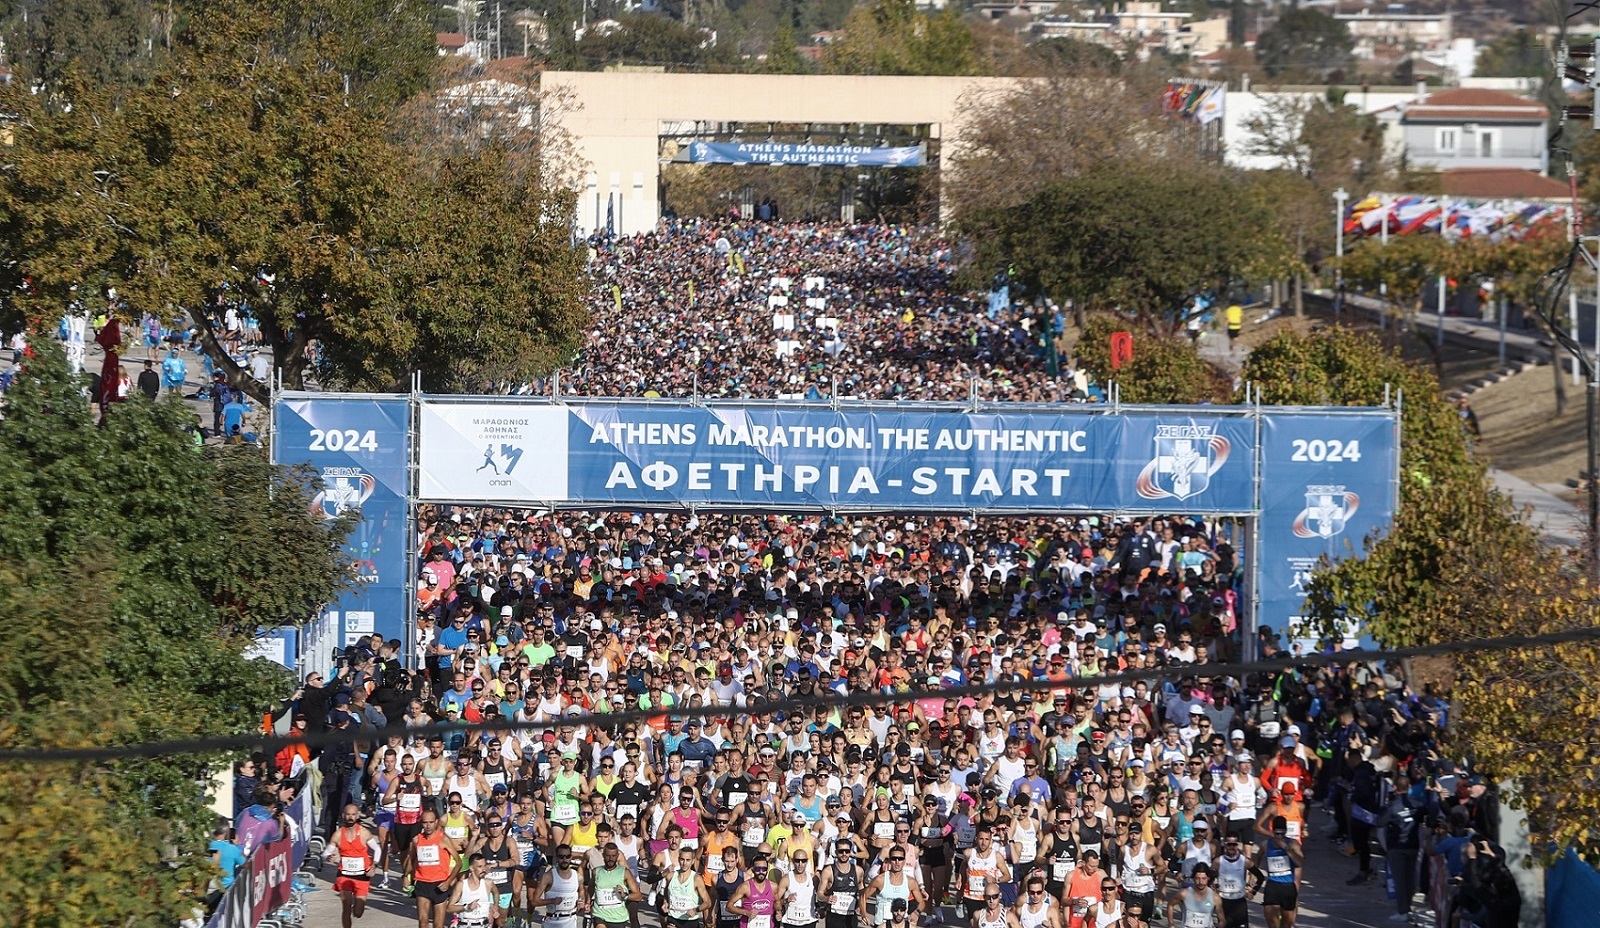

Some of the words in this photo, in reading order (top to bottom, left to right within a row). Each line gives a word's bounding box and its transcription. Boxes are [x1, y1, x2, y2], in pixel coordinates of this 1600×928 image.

[738, 143, 791, 152] ATHENS
[795, 145, 872, 154] MARATHON
[751, 153, 776, 161] THE
[781, 153, 859, 163] AUTHENTIC
[472, 418, 529, 426] ΜΑΡΑΘΩΝΙΟΣ
[483, 426, 519, 434] ΑΘΗΝΑΣ
[1155, 425, 1211, 438] ΣΕΓΑΣ
[308, 429, 378, 452] 2024
[589, 422, 697, 446] ATHENS
[707, 424, 872, 449] MARATHON.
[878, 428, 930, 450] THE
[934, 429, 1087, 452] AUTHENTIC
[1290, 438, 1362, 463] 2024
[323, 466, 362, 477] ΣΕΓΑΣ
